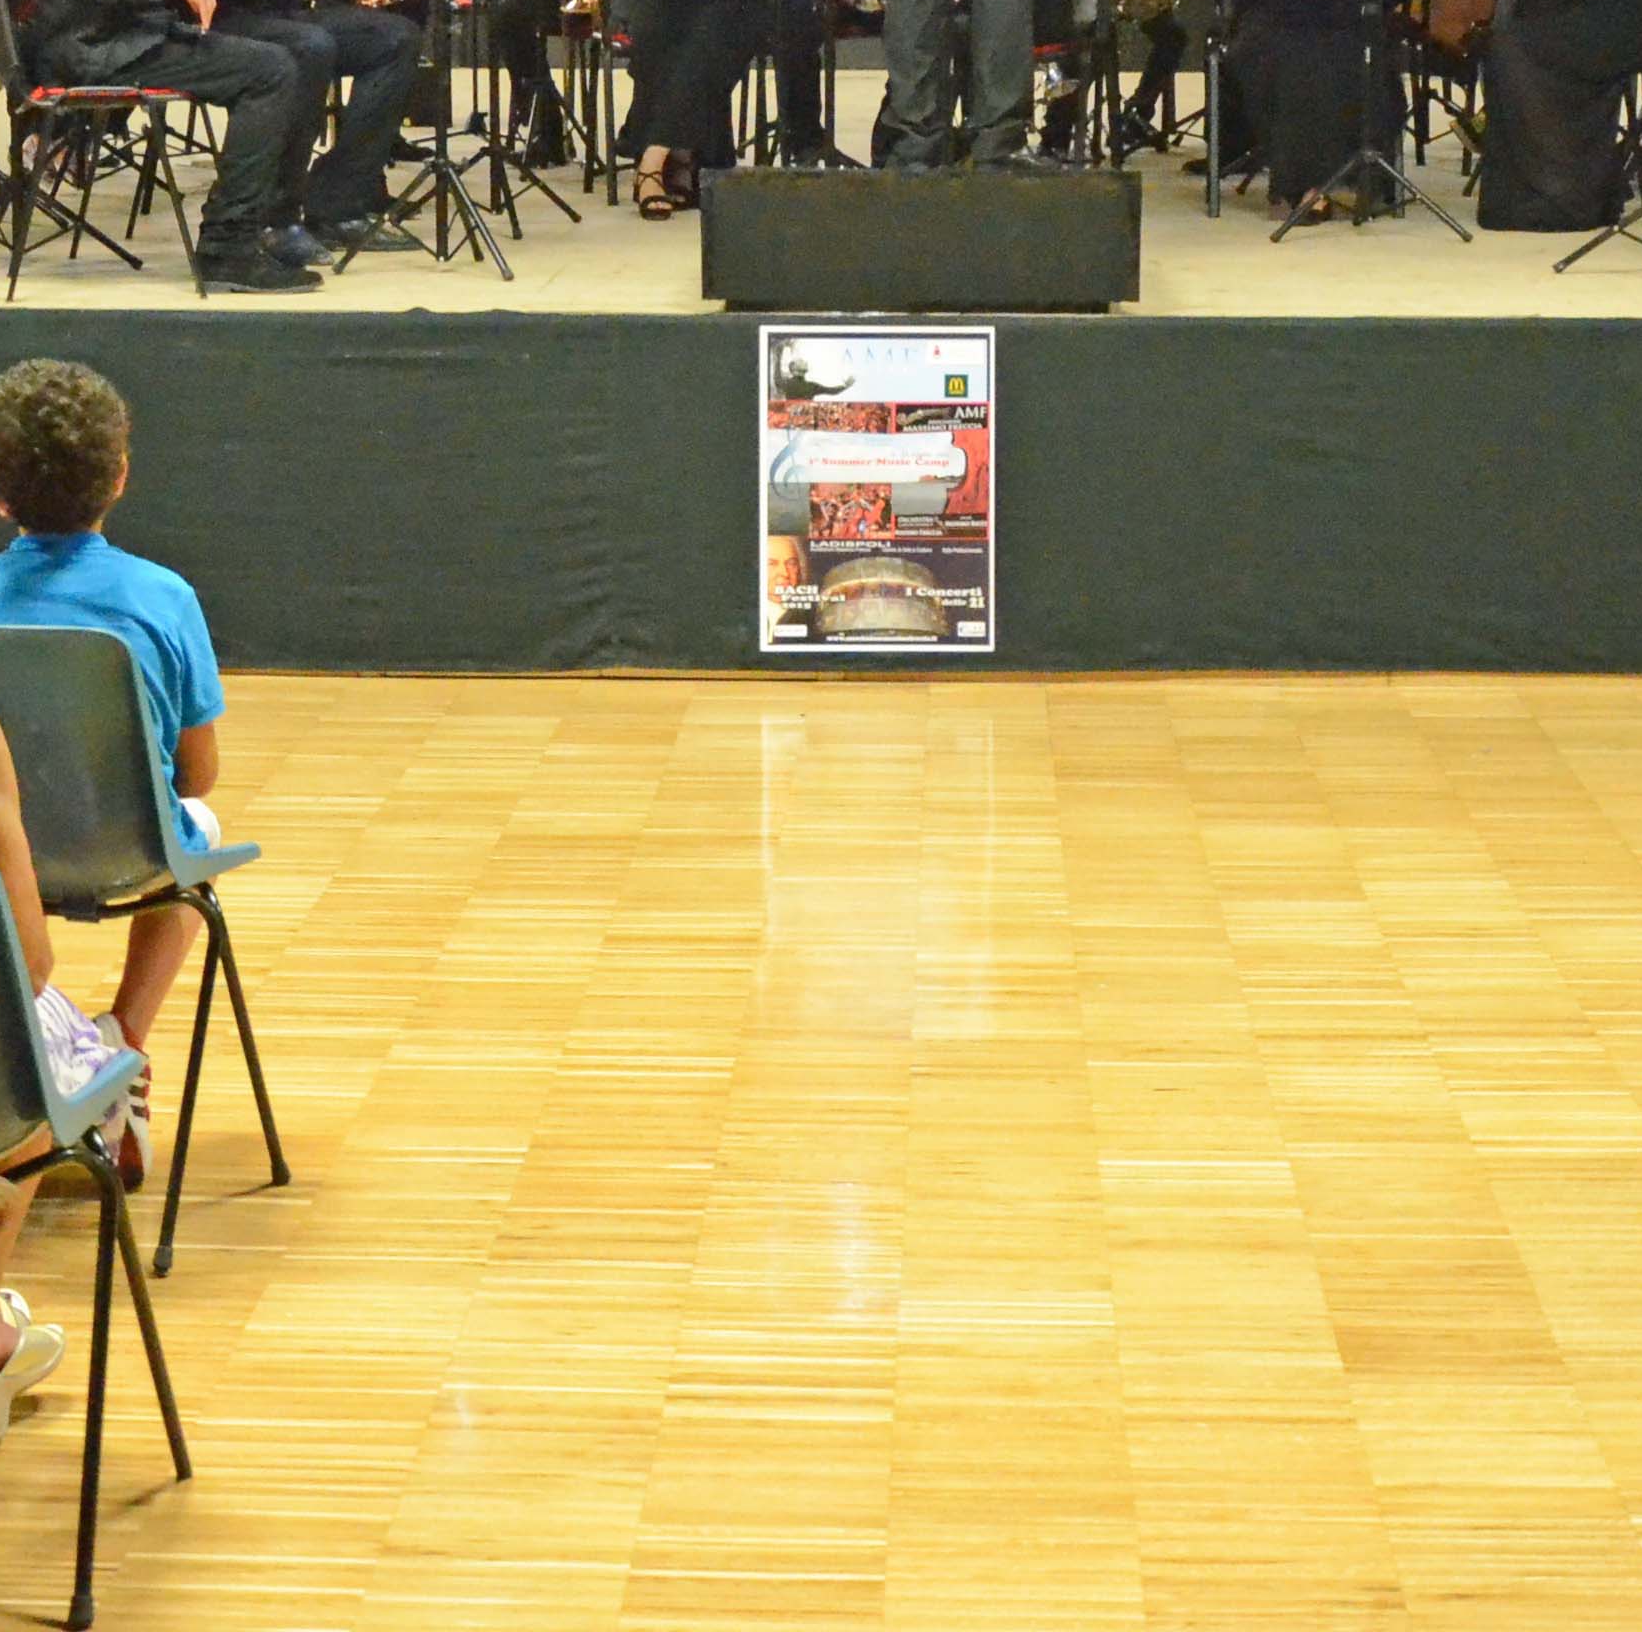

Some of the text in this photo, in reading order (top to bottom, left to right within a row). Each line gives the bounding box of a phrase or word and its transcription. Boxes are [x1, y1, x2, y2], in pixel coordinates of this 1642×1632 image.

[821, 457, 871, 465] Summer
[876, 456, 911, 465] Music
[810, 539, 892, 548] LADISPOLI
[774, 584, 819, 595] BACH
[916, 586, 982, 597] Concerti
[781, 593, 845, 603] Festival
